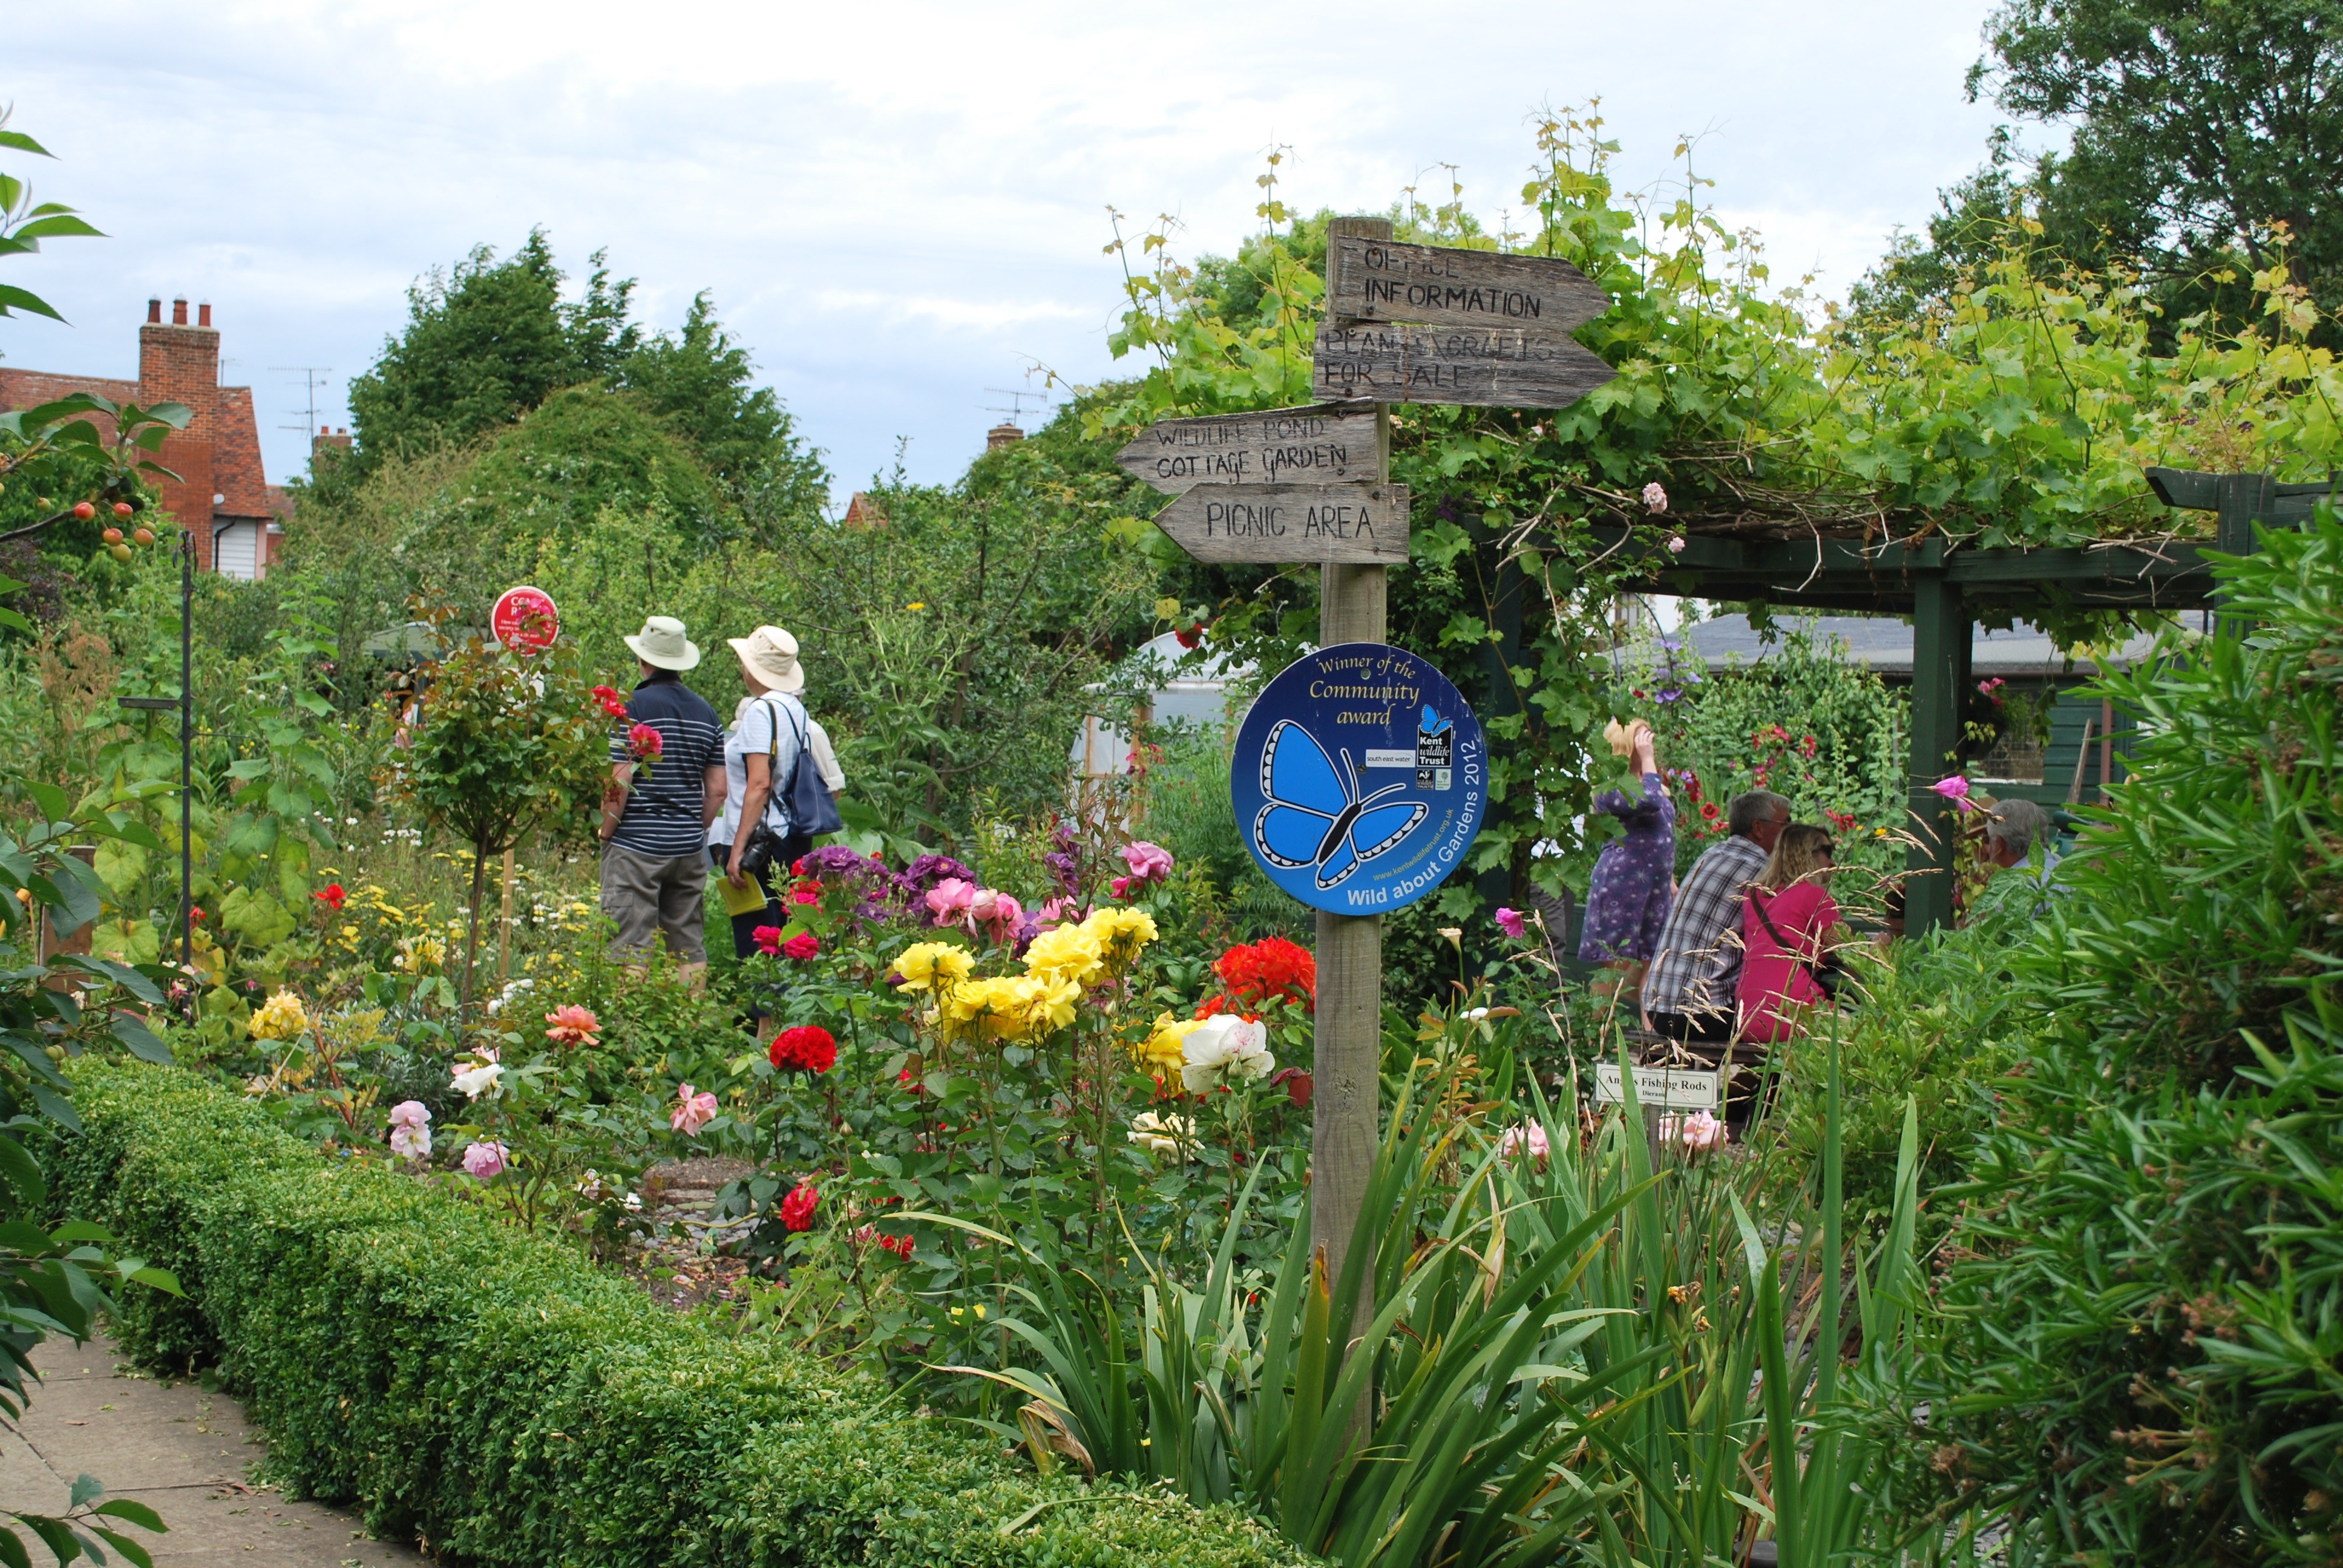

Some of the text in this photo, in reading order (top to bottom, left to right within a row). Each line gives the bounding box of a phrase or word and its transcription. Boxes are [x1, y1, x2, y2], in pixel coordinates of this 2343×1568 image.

[1365, 278, 1541, 318] INFORMATION
[1325, 329, 1425, 356] PLANS
[1325, 363, 1470, 387] FOR SALE
[1156, 418, 1324, 446] WILDLIFE POND
[1157, 443, 1346, 484] COTTAGE GARDEN
[1207, 502, 1374, 538] PICNIC AREA
[1318, 655, 1416, 679] Winner of the
[1310, 680, 1420, 709] Community
[1337, 704, 1397, 725] award
[1420, 736, 1443, 745] Kent
[1420, 745, 1450, 756] wildlife
[1419, 756, 1445, 765] Trust
[1348, 740, 1480, 906] Wild about Gardens 2012
[1642, 1077, 1677, 1090] Fishing
[1681, 1080, 1707, 1091] Rods
